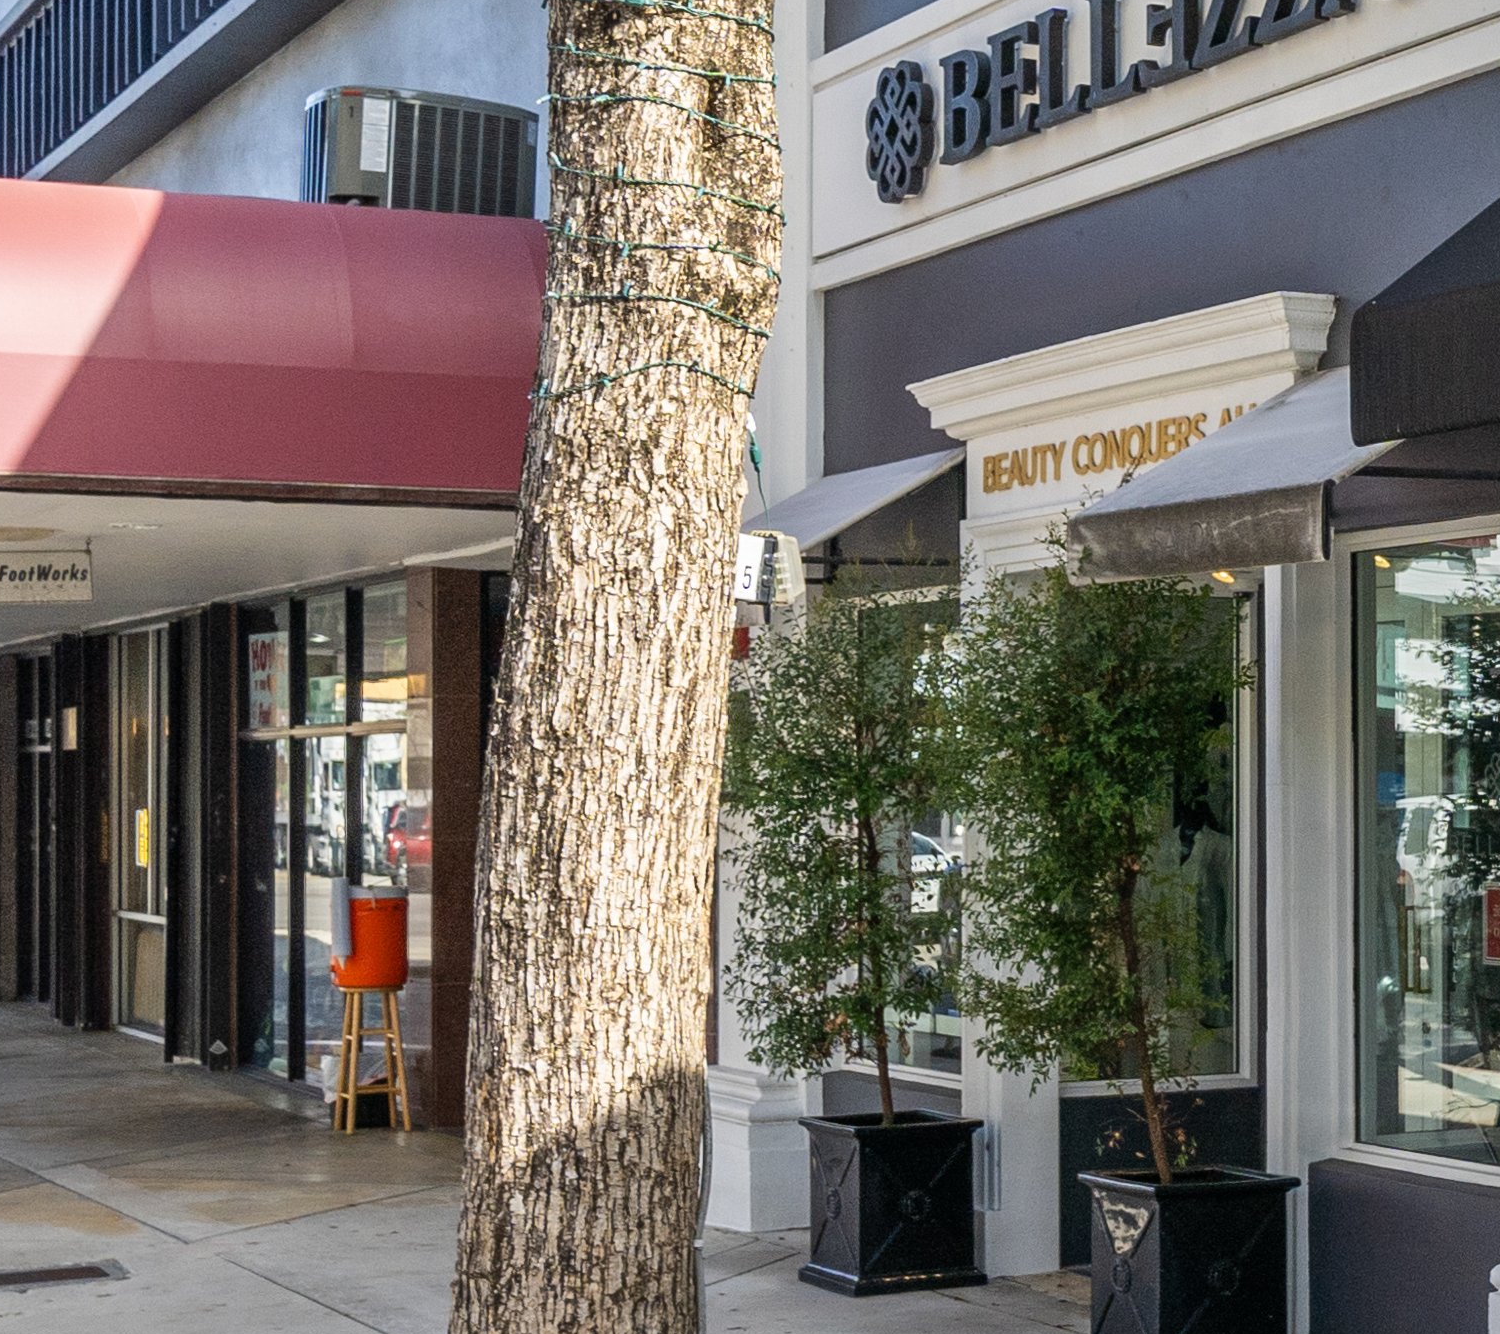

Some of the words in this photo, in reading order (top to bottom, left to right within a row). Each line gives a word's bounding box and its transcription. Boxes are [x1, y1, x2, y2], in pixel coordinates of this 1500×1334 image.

[983, 441, 1067, 495] BEAUTY
[1072, 412, 1207, 477] CONQUERS
[742, 565, 752, 589] 5
